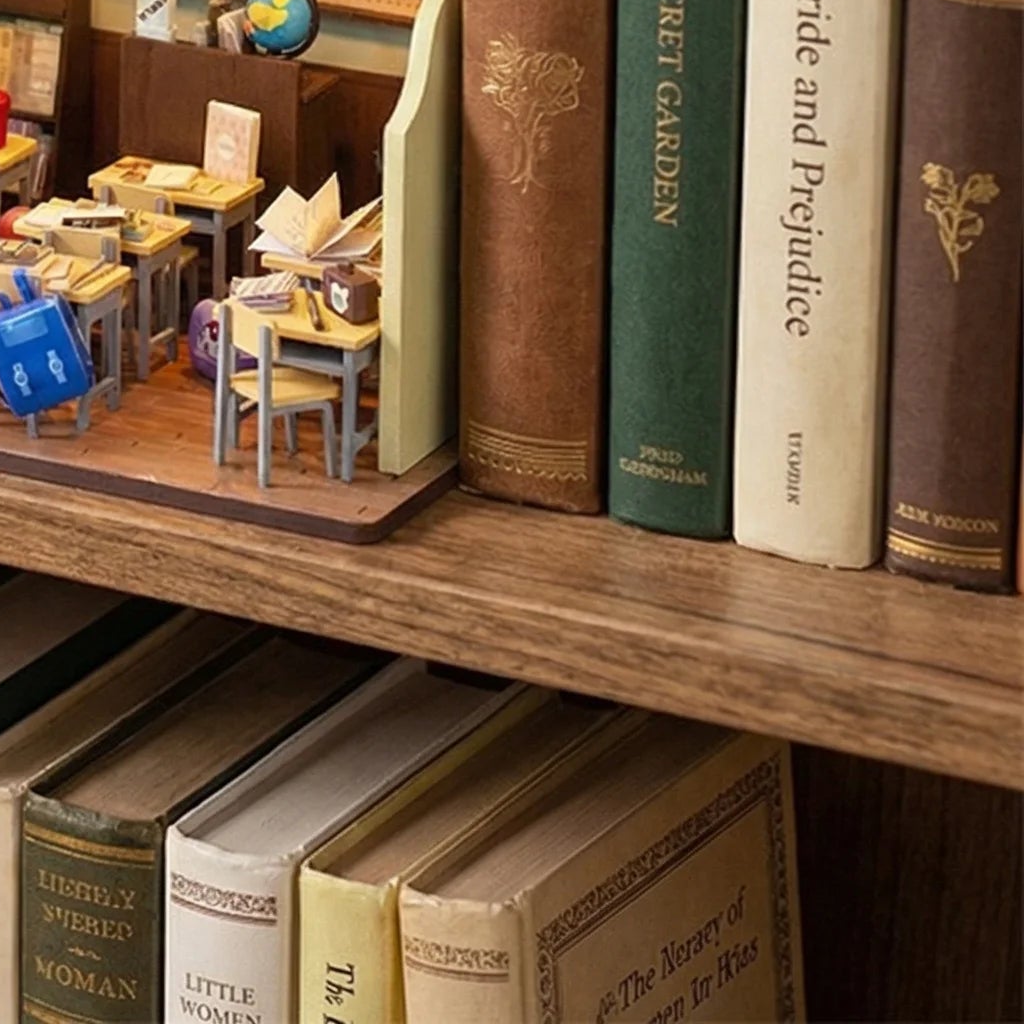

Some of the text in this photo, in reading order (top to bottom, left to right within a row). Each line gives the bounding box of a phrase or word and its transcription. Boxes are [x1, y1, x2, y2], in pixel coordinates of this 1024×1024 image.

[653, 79, 684, 227] GARDEN
[792, 76, 828, 148] and
[779, 158, 826, 338] Prejudice
[185, 972, 256, 1006] LITTLE
[618, 967, 656, 1012] The
[727, 885, 747, 926] of
